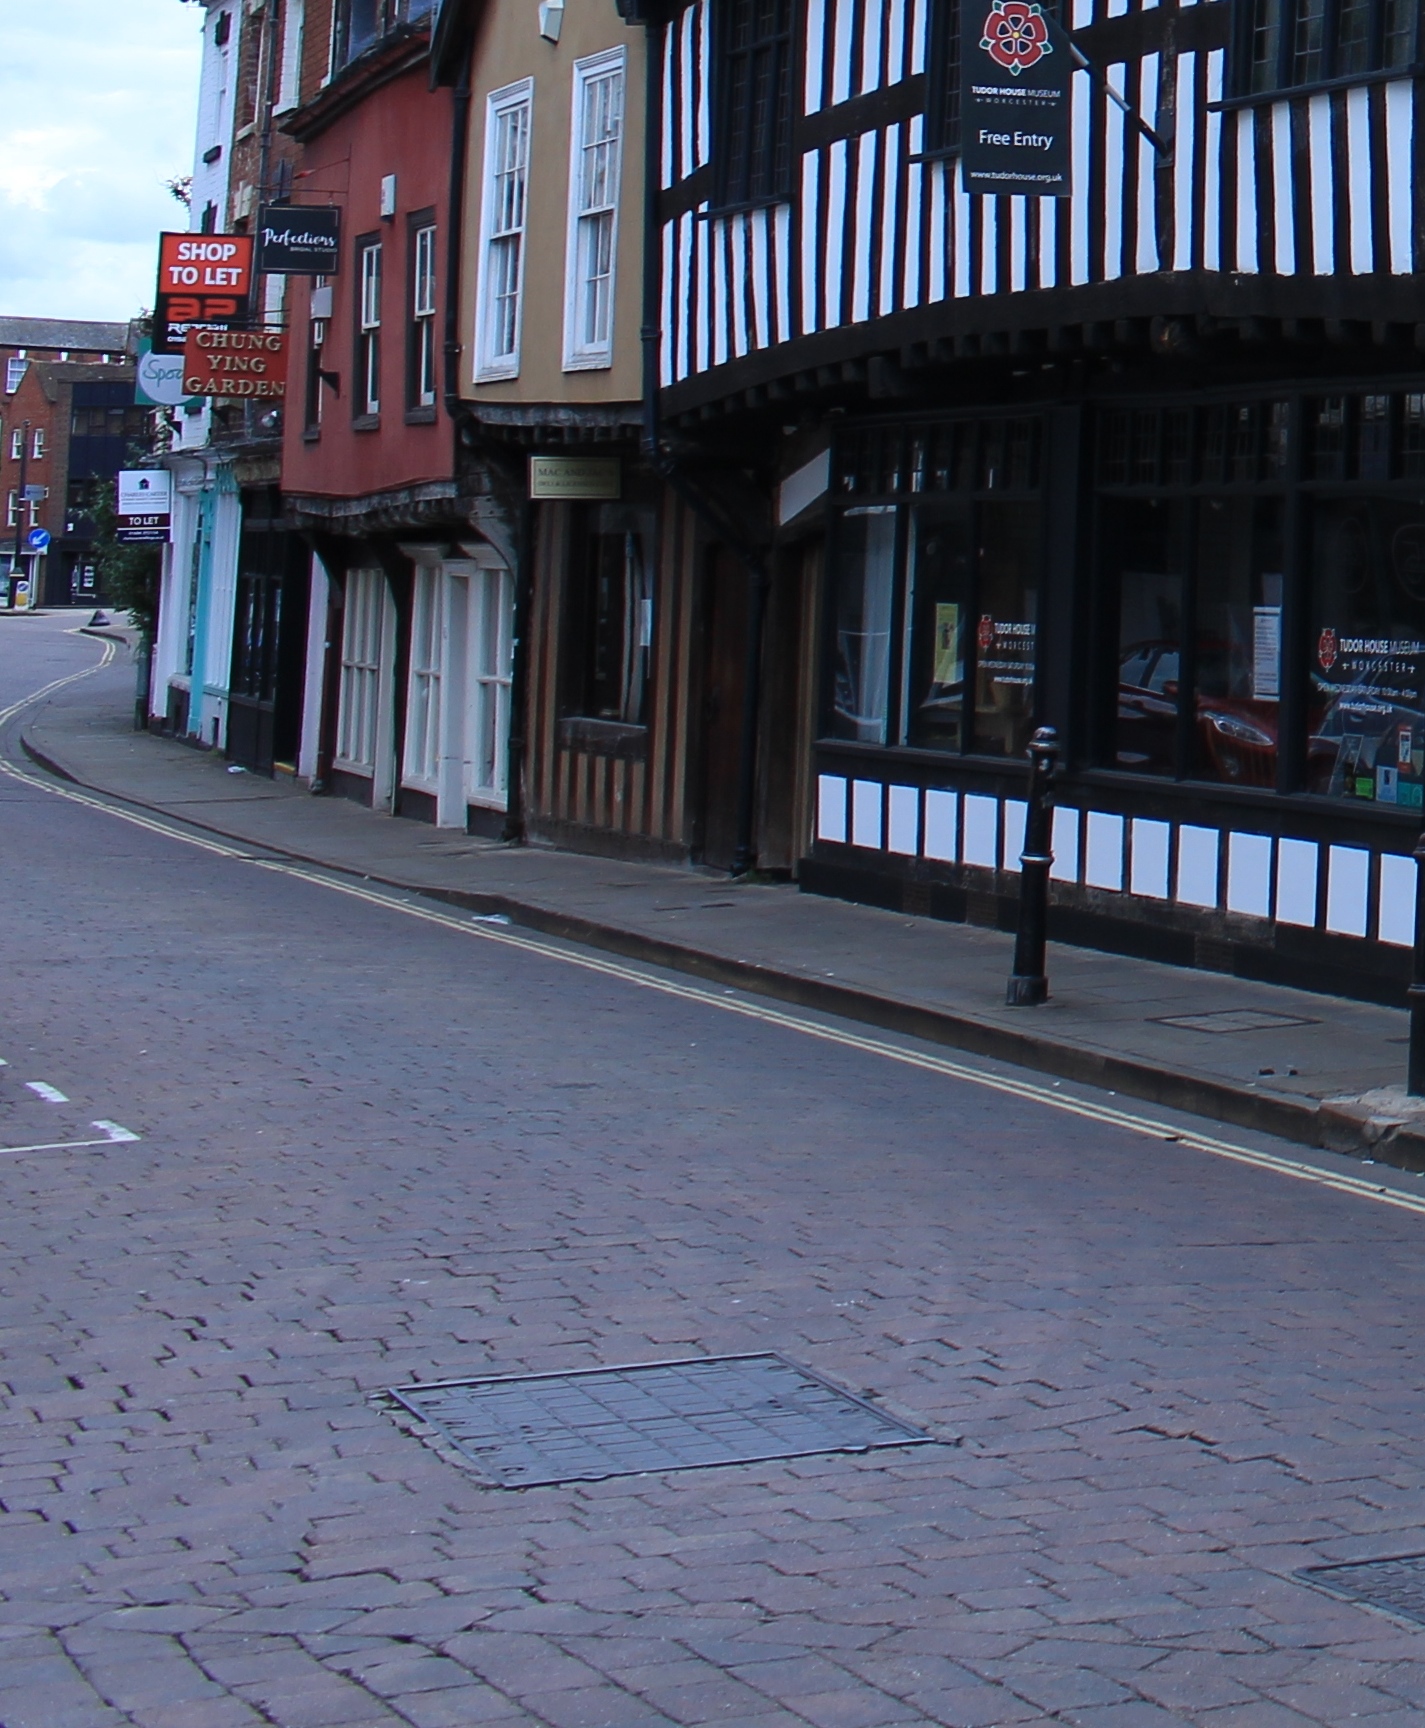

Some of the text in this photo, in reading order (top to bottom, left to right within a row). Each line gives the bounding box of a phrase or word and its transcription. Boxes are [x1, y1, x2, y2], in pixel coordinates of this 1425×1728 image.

[971, 85, 1061, 98] TUDOR HOUSE MUSEUM
[985, 97, 1046, 106] WORCESTER
[979, 129, 1053, 151] Free Entry
[970, 171, 1063, 184] www.tudorhouse.org.uk
[261, 227, 337, 248] Perfections
[177, 242, 236, 262] SHOP
[169, 266, 243, 286] TO LET
[196, 331, 283, 351] CHUNG
[206, 354, 267, 373] YING
[185, 376, 286, 397] GARDEN
[128, 516, 159, 526] TO LET
[994, 622, 1012, 634] TUDOR
[1012, 623, 1030, 635] HOUSE
[1340, 638, 1420, 655] TUDOR HOUSE MUSEUM
[1351, 660, 1406, 673] WORCESTER
[1339, 702, 1393, 715] www.tudorhouse.org.uk
